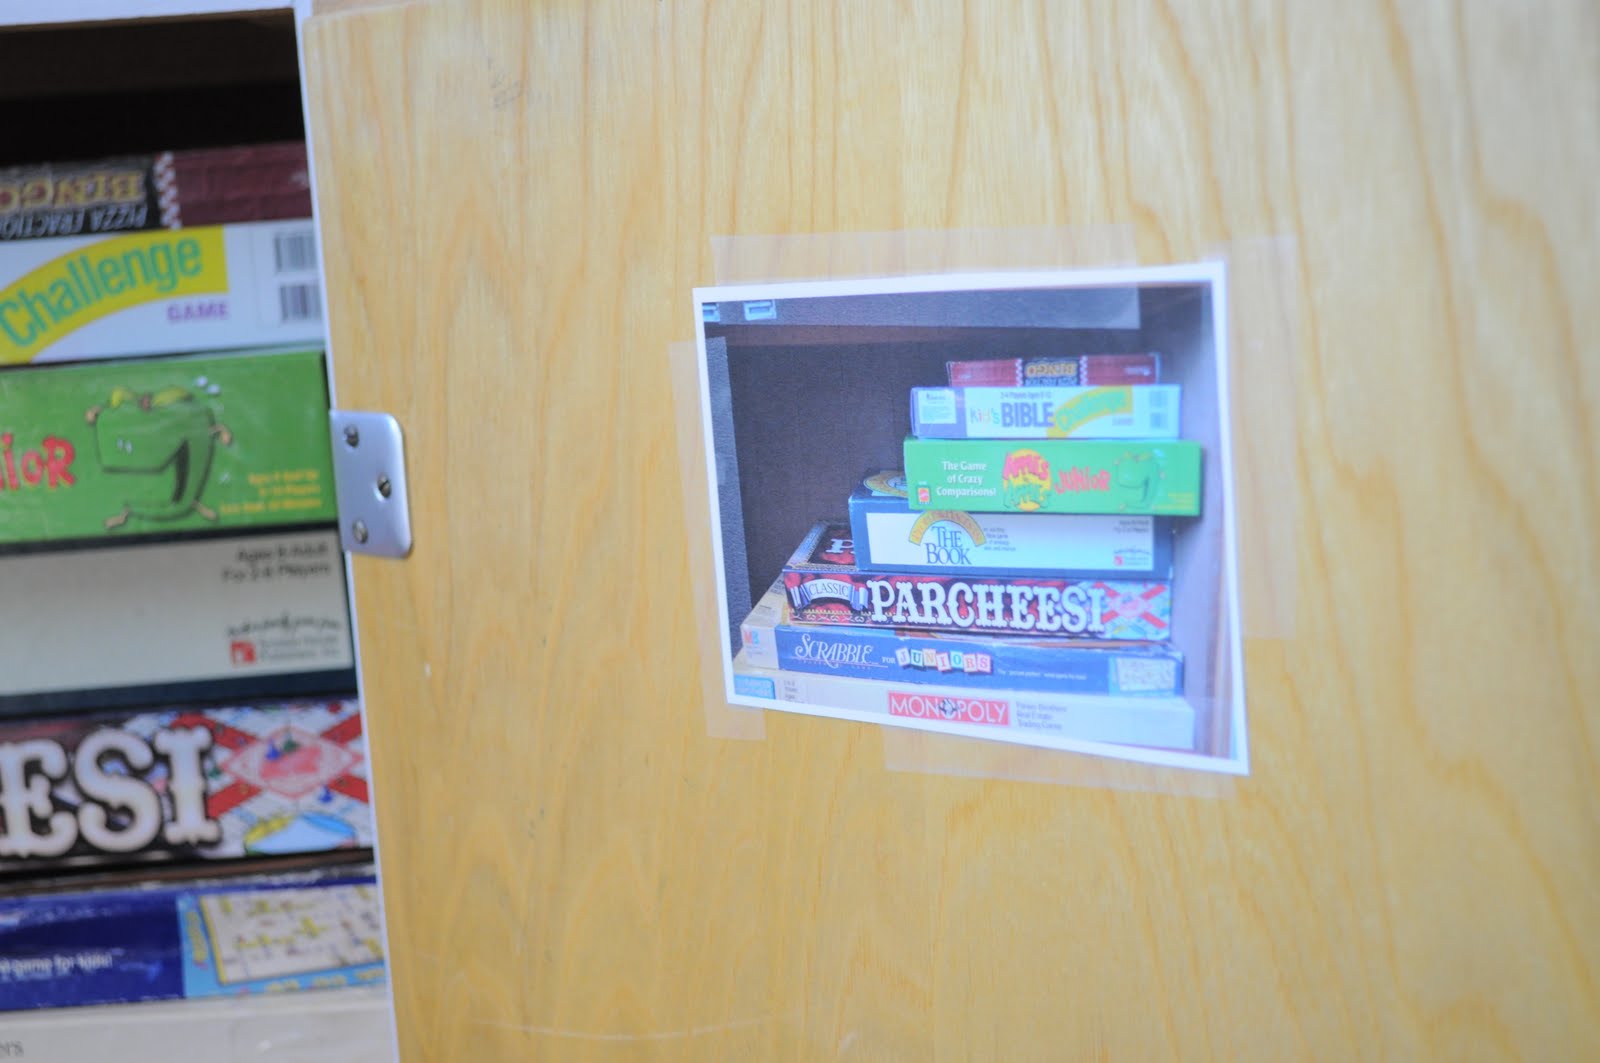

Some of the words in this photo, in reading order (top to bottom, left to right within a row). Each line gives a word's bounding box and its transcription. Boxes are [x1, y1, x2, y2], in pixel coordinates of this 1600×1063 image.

[0, 236, 203, 348] Challenge
[166, 302, 229, 322] GAME
[1001, 402, 1056, 428] BIBLE
[942, 461, 959, 471] The
[960, 461, 987, 471] Game
[946, 474, 958, 483] of
[958, 474, 983, 486] Crazy
[936, 486, 997, 499] Comparisons!
[931, 526, 963, 548] THE
[923, 542, 972, 565] BOOK
[808, 582, 850, 599] CLASSIC
[866, 579, 1105, 633] PARCHEESI
[882, 656, 896, 664] FOR
[898, 648, 992, 672] JUNIORS
[890, 696, 1007, 723] MONOPOLY
